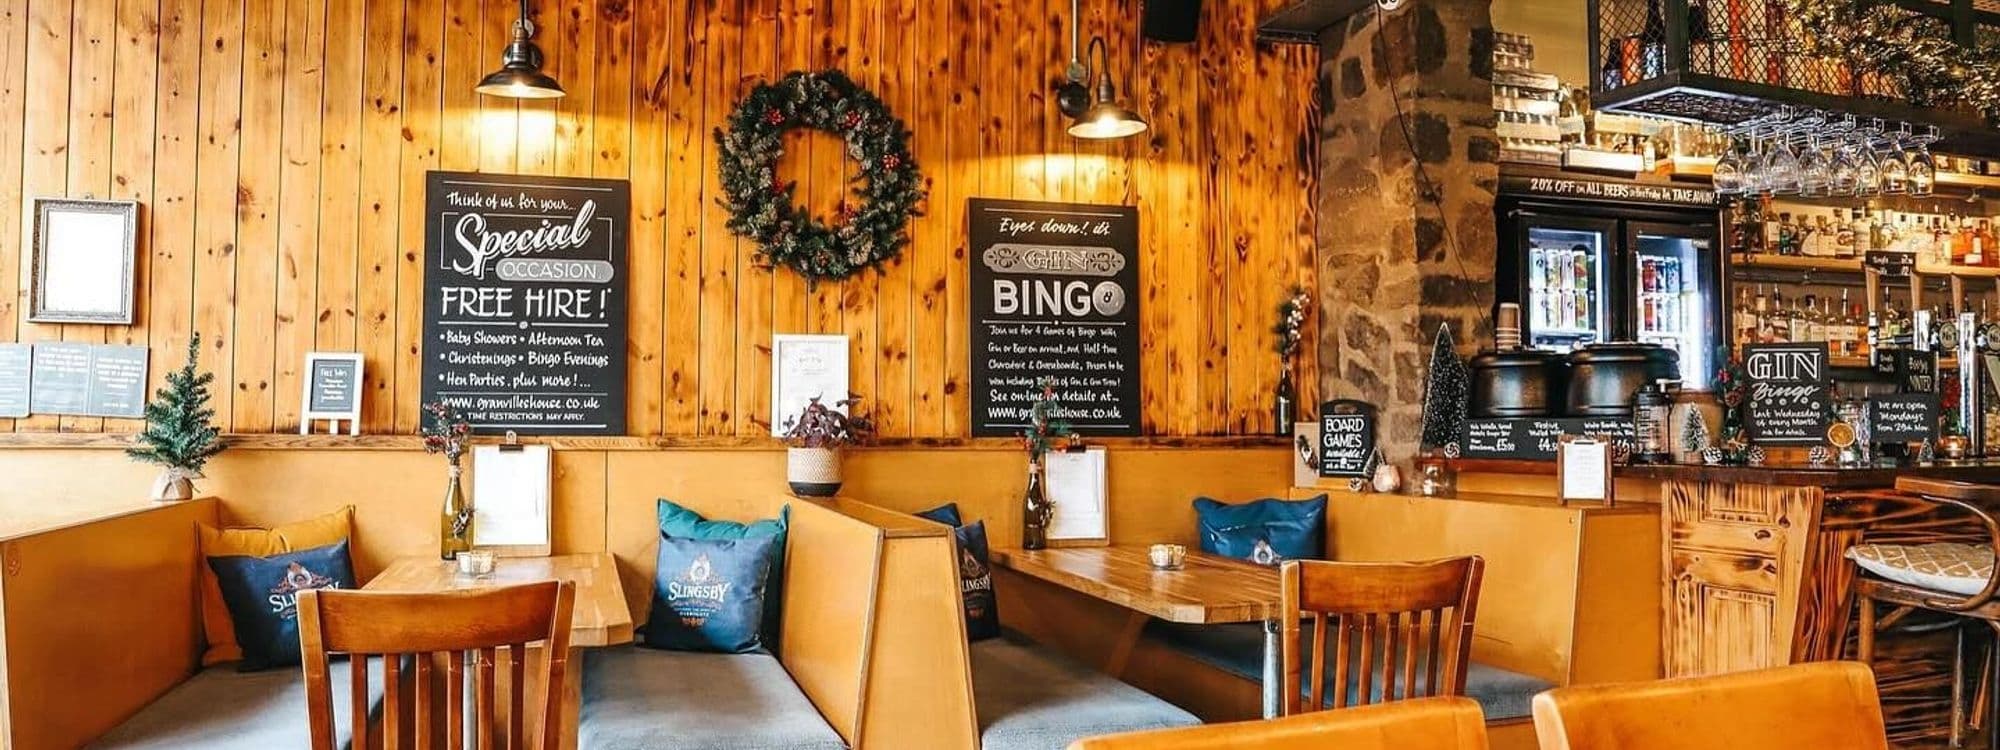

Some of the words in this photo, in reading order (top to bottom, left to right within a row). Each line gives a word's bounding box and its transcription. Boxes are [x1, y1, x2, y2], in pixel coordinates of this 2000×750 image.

[1531, 178, 1552, 191] 20%
[1555, 180, 1577, 194] OFF
[1585, 182, 1602, 196] ALL
[1604, 183, 1629, 198] BEERS
[446, 191, 482, 207] Think
[485, 194, 497, 210] of
[500, 196, 515, 208] us
[519, 192, 537, 210] for
[999, 217, 1035, 236] Eyes
[452, 199, 597, 280] Special
[1022, 248, 1090, 272] GIN
[441, 286, 513, 317] FREE
[993, 279, 1126, 317] BINGO
[446, 330, 471, 346] Baby
[474, 330, 517, 345] Showers
[528, 332, 582, 346] Afternoon
[584, 334, 604, 347] Tea
[989, 325, 1008, 336] Join
[1008, 326, 1018, 335] us
[1020, 324, 1033, 336] for
[1035, 325, 1041, 335] 4
[1043, 325, 1065, 336] Games
[1067, 327, 1076, 338] of
[1078, 326, 1097, 338] Bingo
[988, 342, 1002, 353] Gin
[1003, 344, 1012, 353] or
[1028, 344, 1038, 353] on
[448, 351, 517, 366] Christenings
[528, 351, 561, 368] Bingo
[564, 351, 609, 368] Evenings
[1747, 352, 1820, 380] GIN
[446, 371, 468, 386] Hen
[512, 371, 537, 389] plus
[1060, 376, 1069, 388] of
[990, 389, 1008, 402] See
[1062, 389, 1096, 402] details
[1751, 382, 1820, 403] Bingo
[1753, 409, 1771, 419] Last
[1774, 409, 1820, 419] Wednesday
[1879, 402, 1890, 410] We
[1892, 402, 1905, 410] are
[1906, 402, 1928, 411] open
[467, 412, 486, 420] TIME
[489, 412, 543, 421] RESTRICTIONS
[546, 412, 562, 421] MAY
[1769, 419, 1790, 428] every
[1879, 412, 1924, 422] Mondays
[1325, 418, 1365, 433] BOARD
[1323, 433, 1362, 448] GAMES
[961, 571, 991, 593] LINGSBY
[668, 581, 732, 604] SLINGSBY
